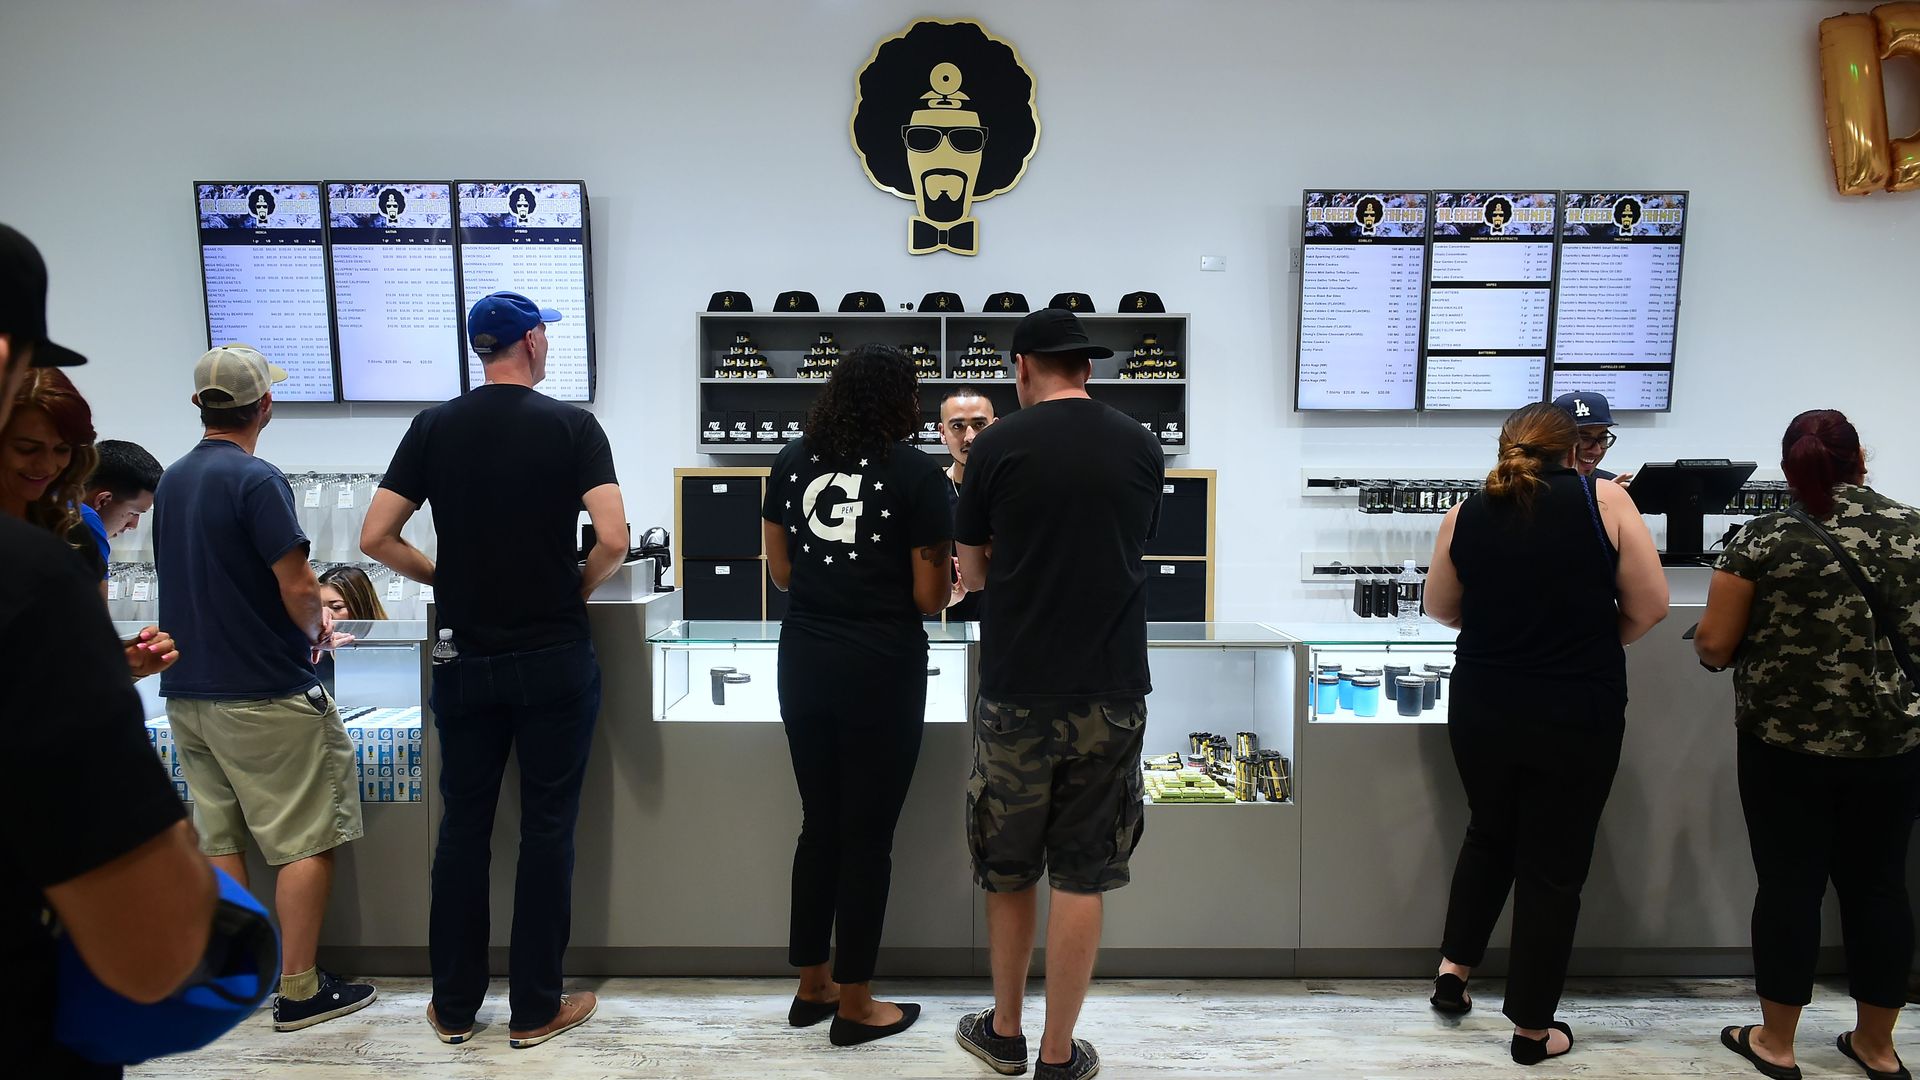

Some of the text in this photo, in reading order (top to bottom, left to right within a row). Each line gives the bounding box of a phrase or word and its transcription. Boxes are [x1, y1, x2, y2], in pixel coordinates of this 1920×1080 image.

[1573, 399, 1591, 417] LA
[802, 472, 864, 544] G
[841, 505, 854, 514] PEN
